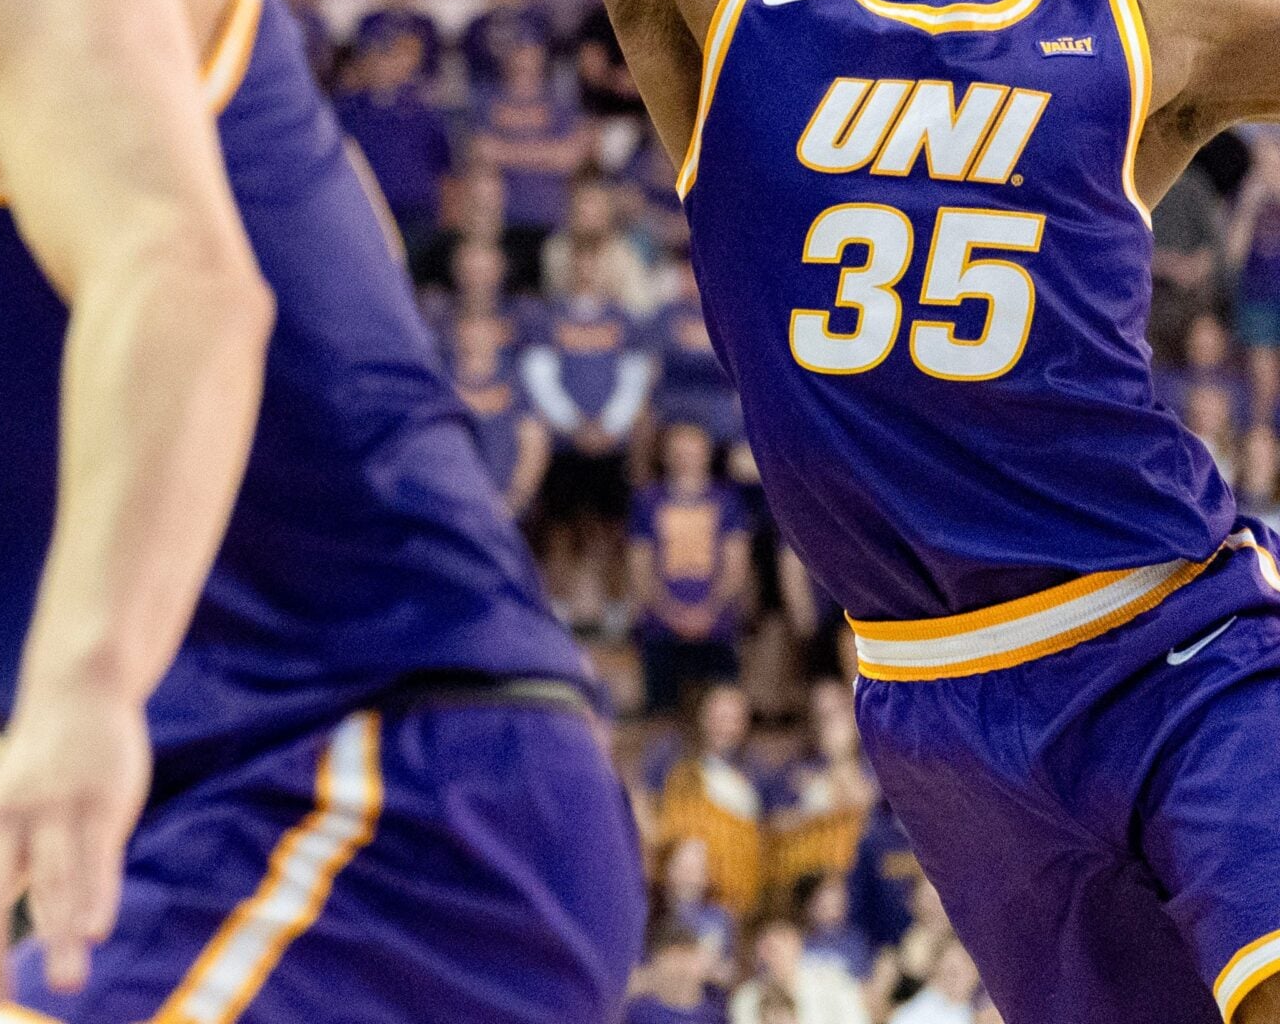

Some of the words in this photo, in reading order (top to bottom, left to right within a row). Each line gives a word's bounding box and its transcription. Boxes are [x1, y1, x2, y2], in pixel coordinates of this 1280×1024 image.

[1039, 37, 1093, 54] VALLEY
[796, 77, 1052, 185] UNI
[789, 202, 1047, 382] 35
